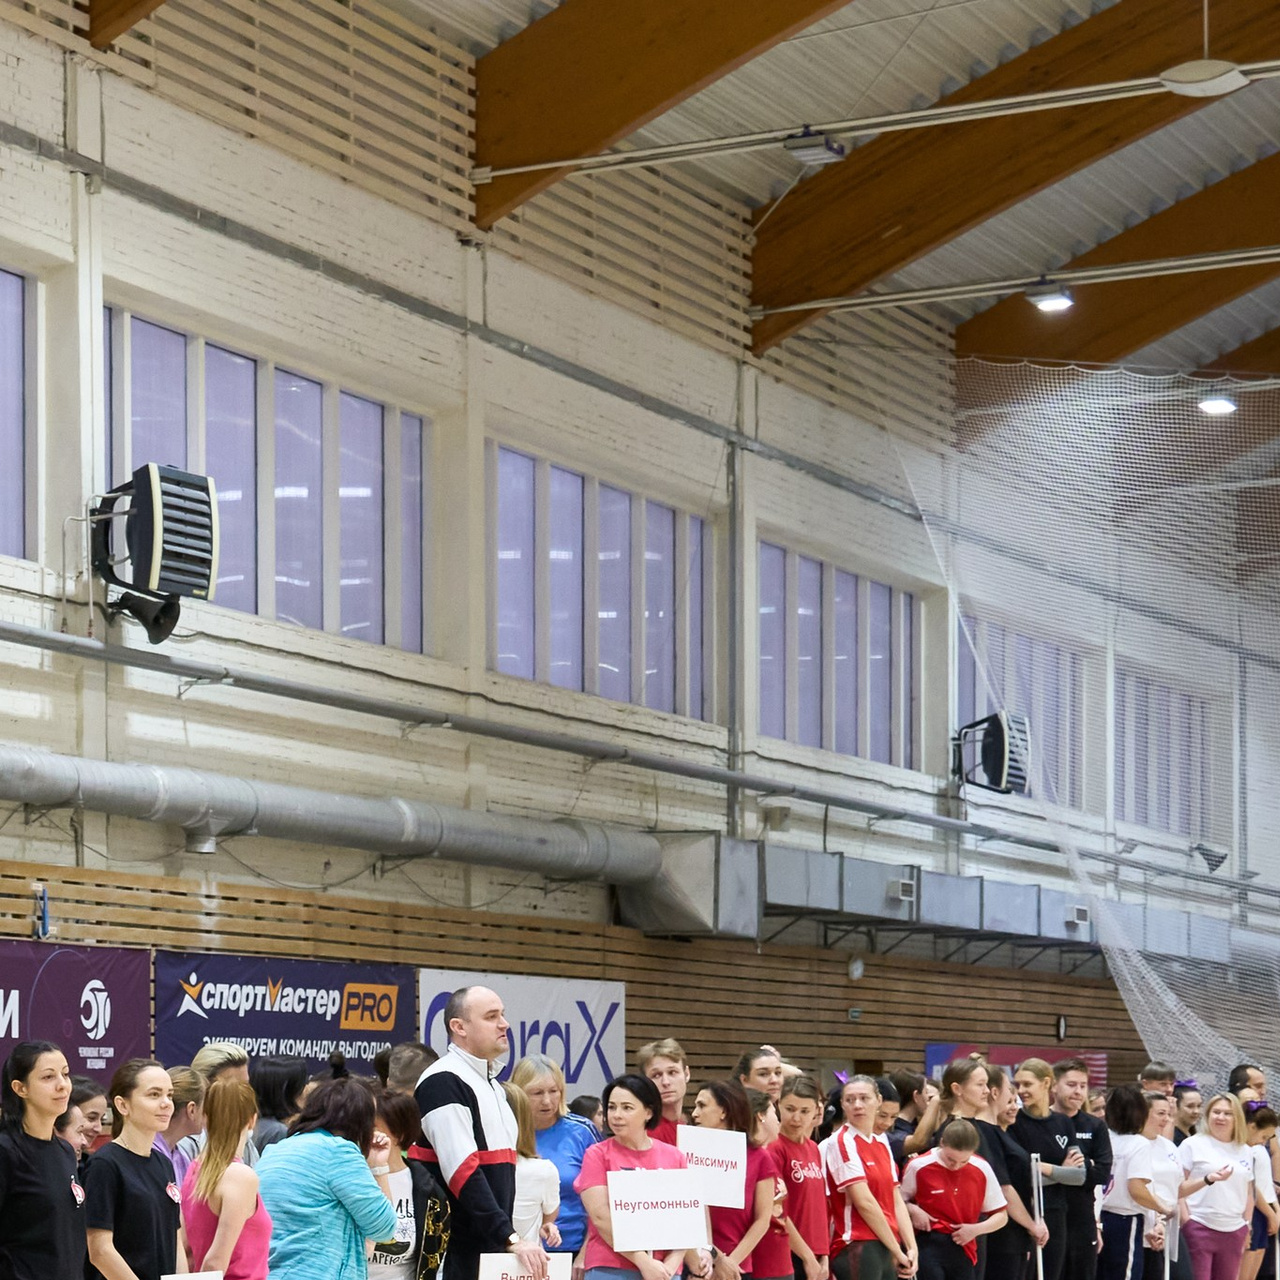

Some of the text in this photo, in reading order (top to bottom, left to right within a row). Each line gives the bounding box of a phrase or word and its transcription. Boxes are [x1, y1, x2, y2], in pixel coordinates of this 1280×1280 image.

[344, 991, 393, 1023] PRO
[279, 1038, 336, 1062] КОМАНДУ
[686, 1152, 738, 1172] Максимум
[614, 1199, 700, 1213] Неугомонные
